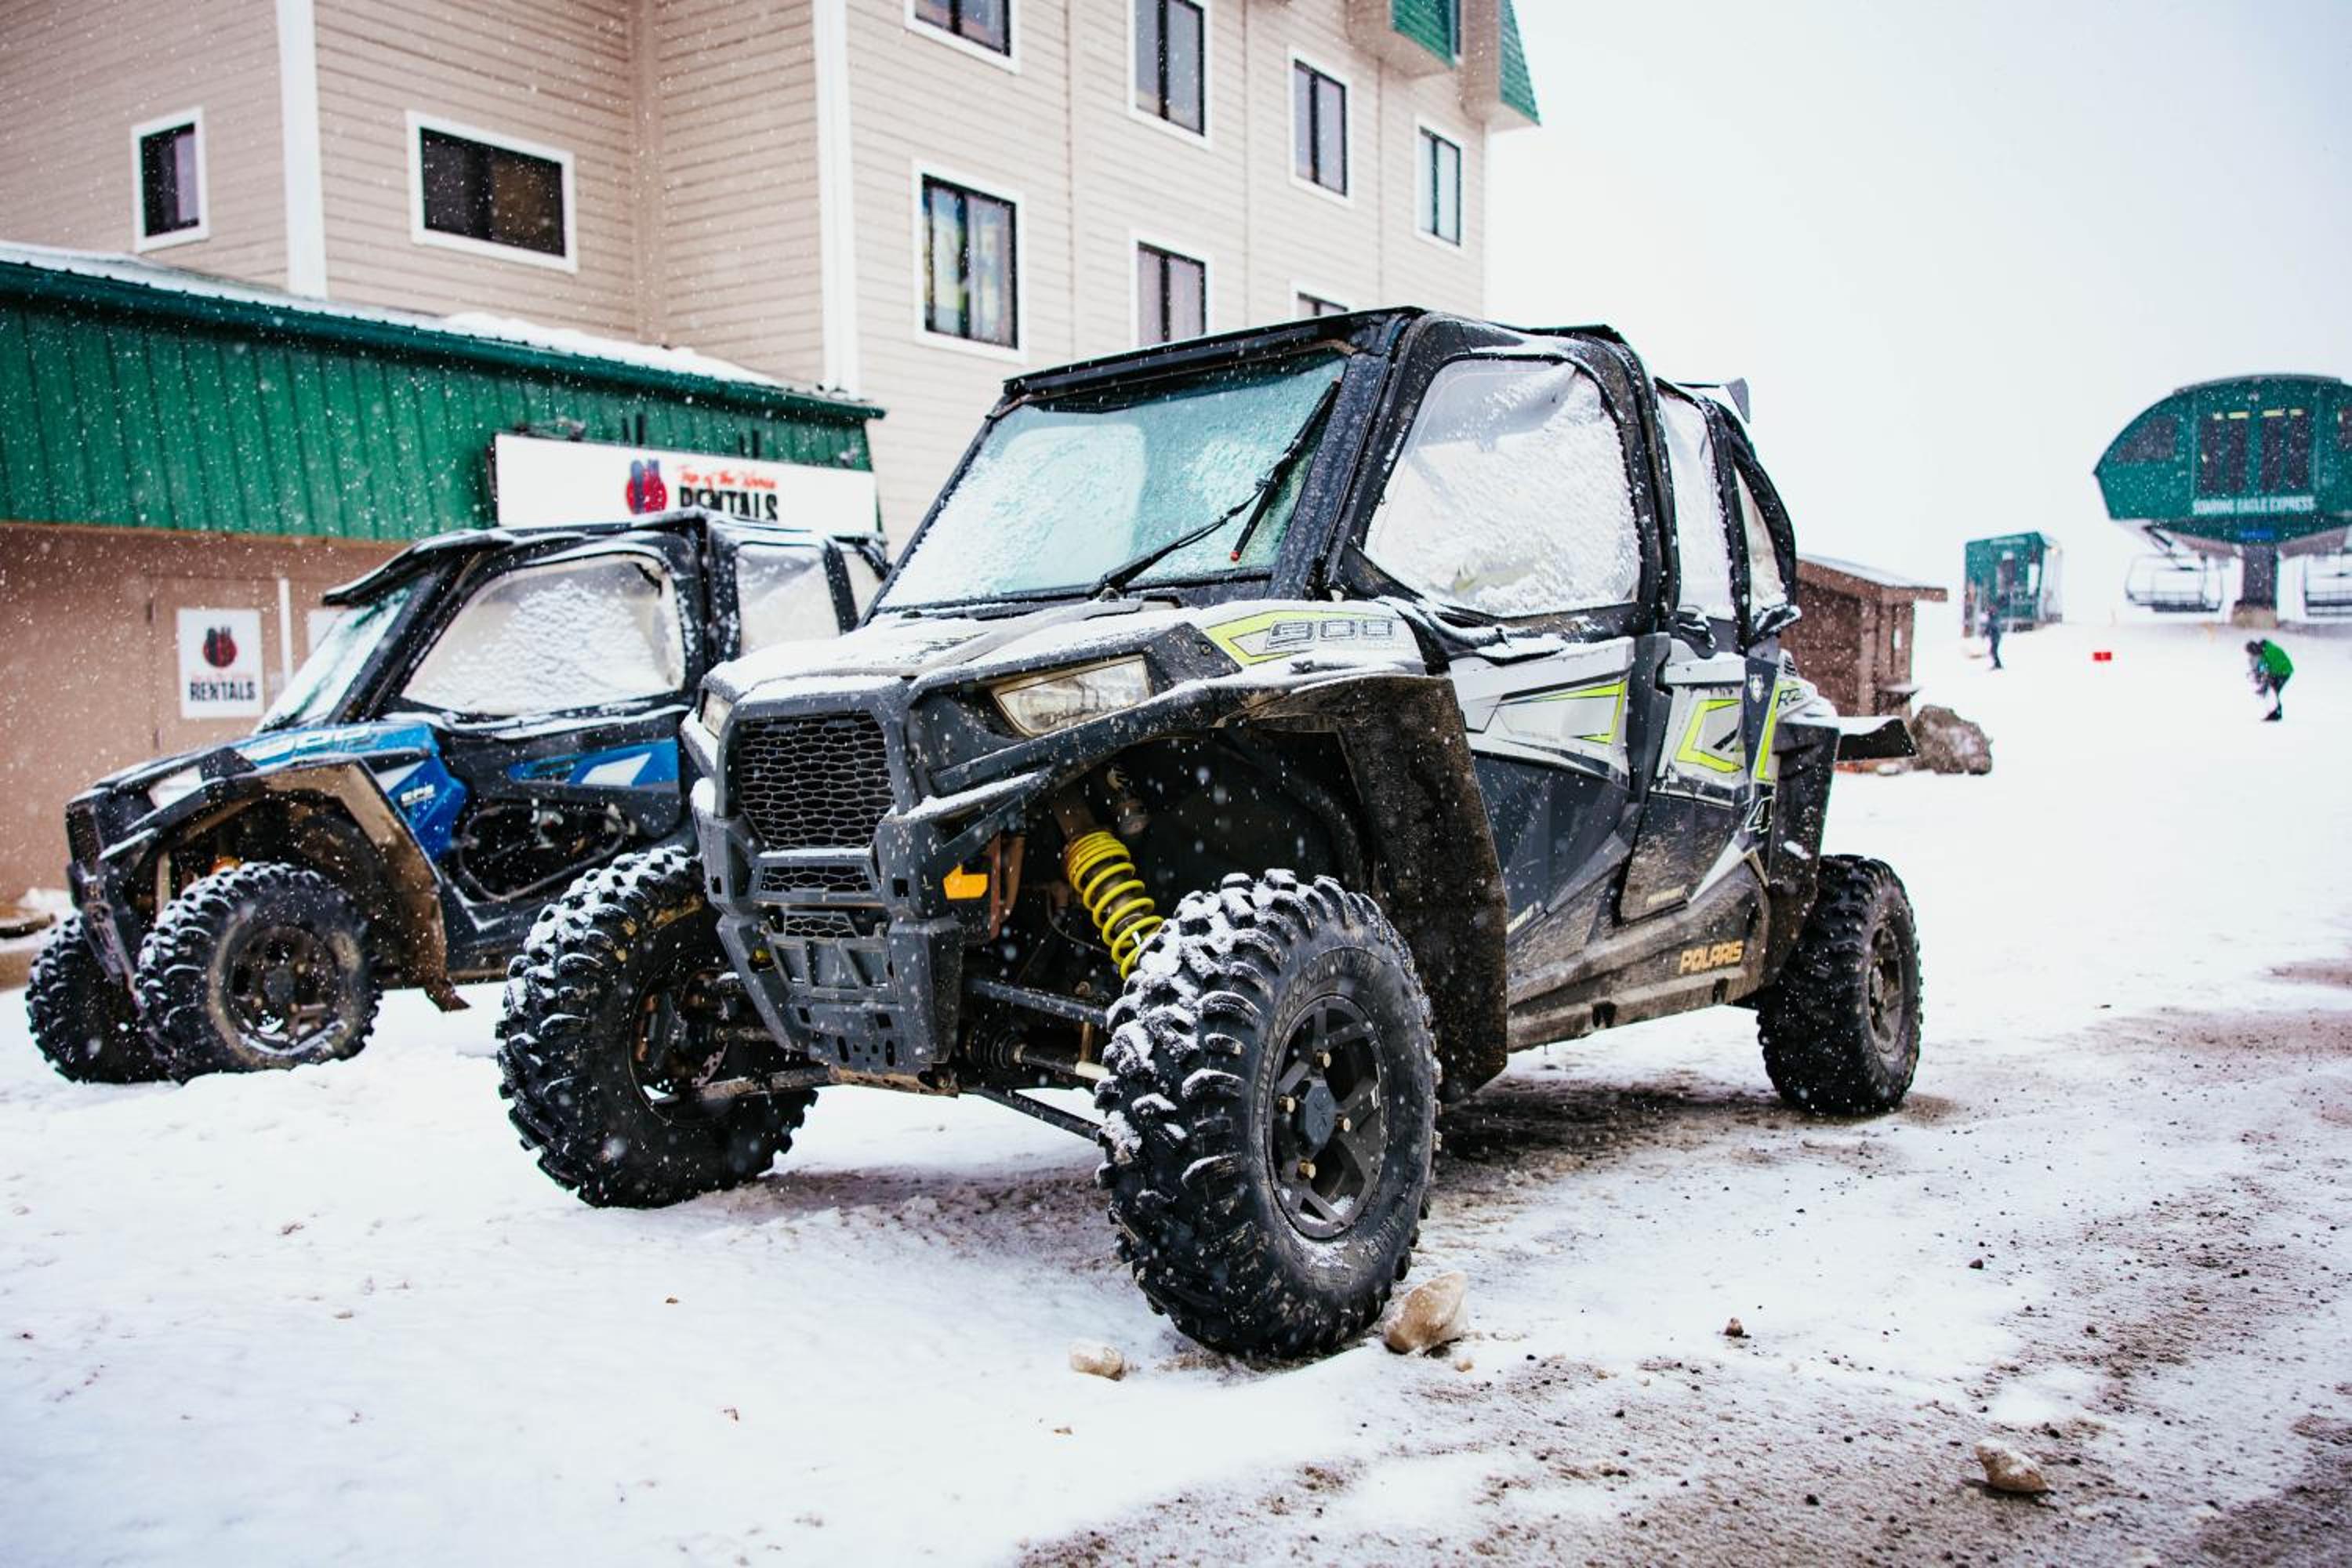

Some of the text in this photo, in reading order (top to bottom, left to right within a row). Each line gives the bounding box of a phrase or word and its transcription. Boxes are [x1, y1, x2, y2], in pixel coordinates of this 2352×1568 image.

[1266, 619, 1395, 650] 900
[190, 681, 256, 702] RENTALS
[1679, 941, 1744, 975] POLARIS
